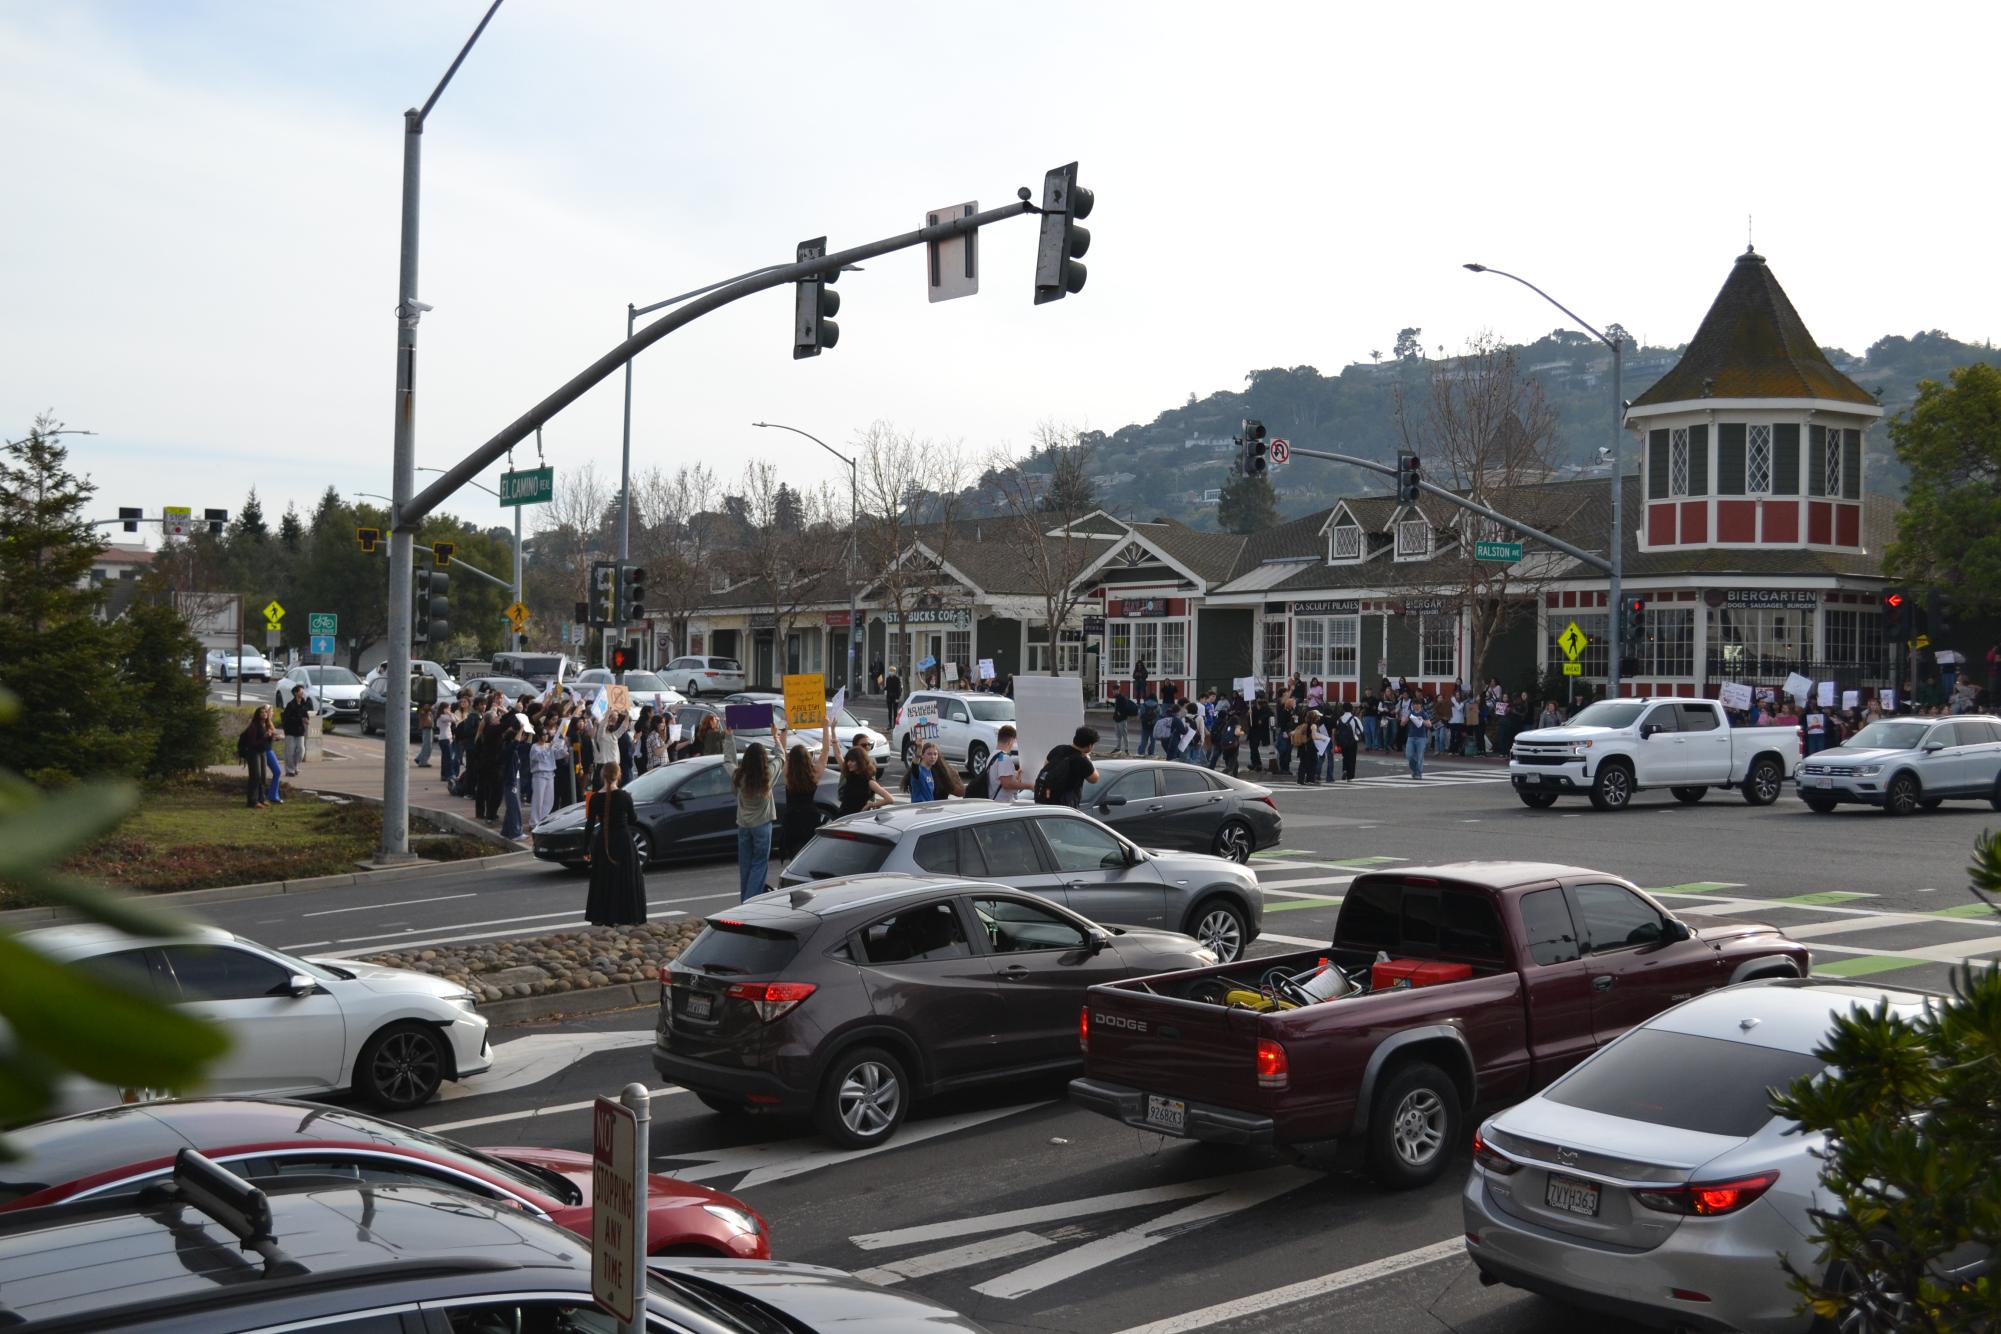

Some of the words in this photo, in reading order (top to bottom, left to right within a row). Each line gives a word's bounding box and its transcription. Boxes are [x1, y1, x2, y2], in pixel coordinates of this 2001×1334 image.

[501, 479, 512, 499] EL
[511, 475, 539, 499] CAMINO
[540, 479, 551, 490] REAL
[1477, 545, 1510, 558] RALSTON
[1511, 549, 1521, 557] AVE
[1294, 602, 1304, 611] CA
[1305, 601, 1331, 611] SCULPT
[1332, 600, 1359, 610] PILATES
[1727, 590, 1816, 601] BIERGARTEN
[791, 703, 820, 712] ABOLISH
[792, 711, 822, 724] ICE!
[1095, 1013, 1147, 1032] DODGE
[596, 1109, 611, 1152] NO
[596, 1165, 632, 1220] STOPPING
[1550, 1183, 1597, 1209] 7VYH363
[604, 1215, 622, 1251] ANY
[603, 1252, 623, 1289] TIME
